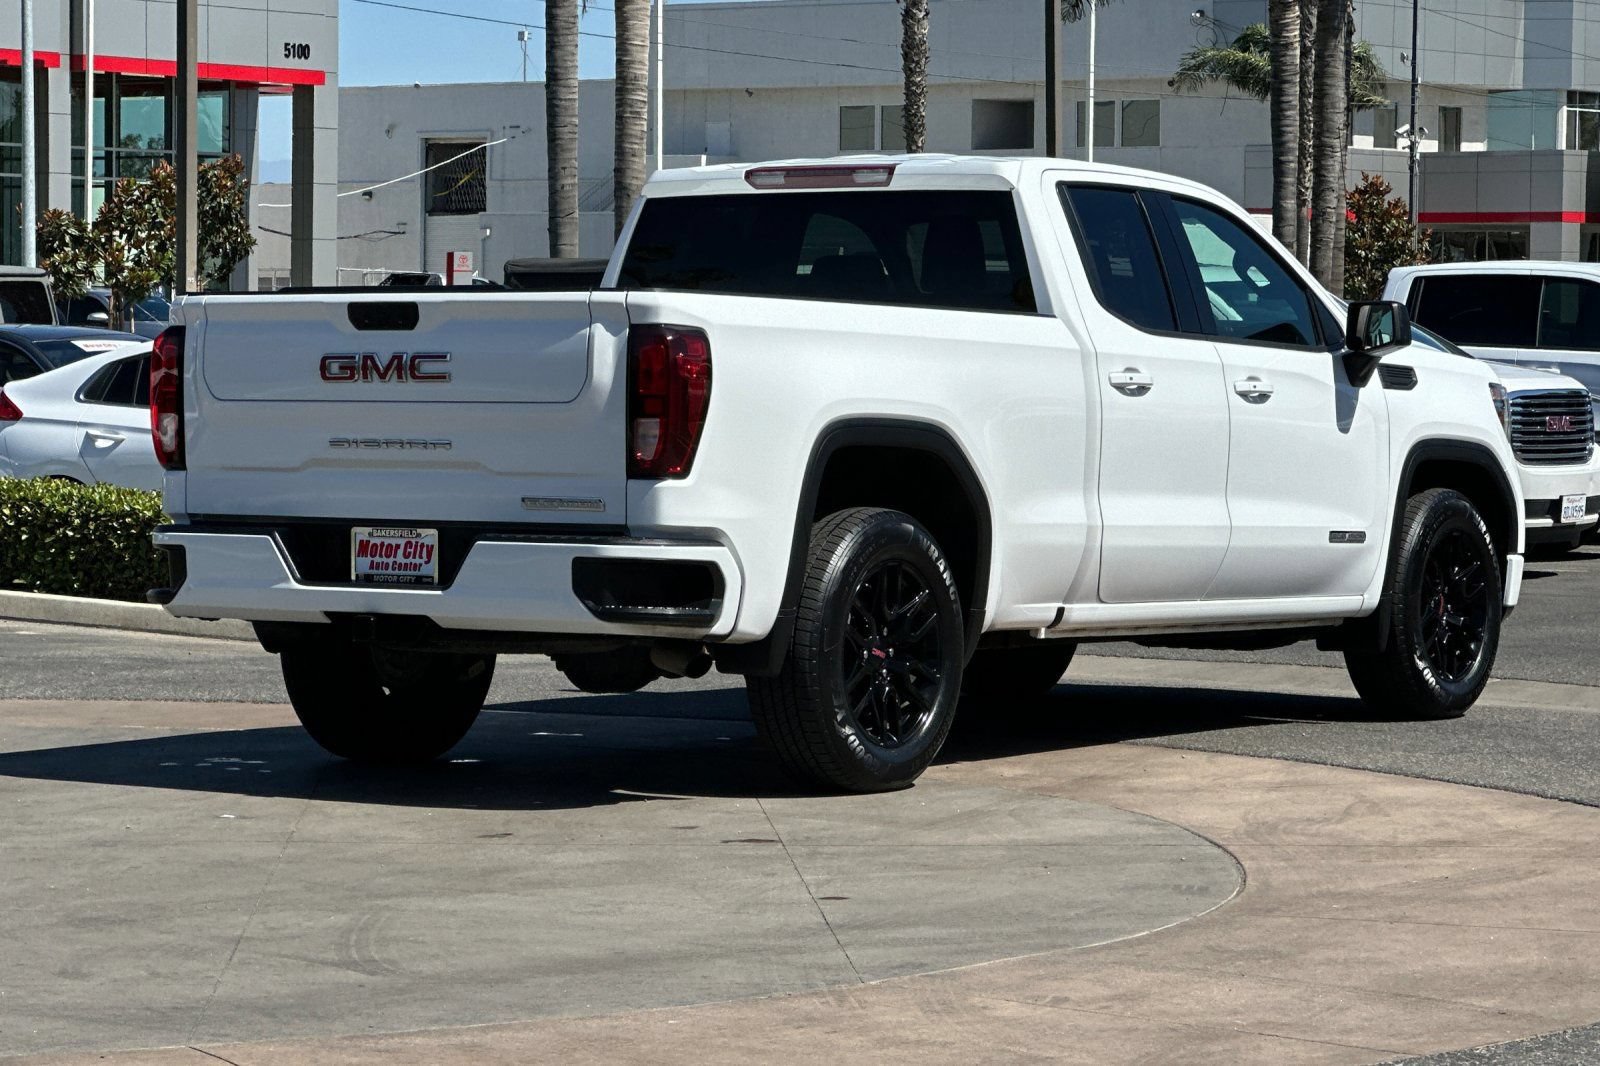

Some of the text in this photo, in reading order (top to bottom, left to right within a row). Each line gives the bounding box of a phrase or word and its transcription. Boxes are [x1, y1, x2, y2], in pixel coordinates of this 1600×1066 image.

[283, 42, 311, 60] 5100
[320, 352, 451, 383] GMC
[328, 438, 452, 450] SIERRA
[372, 529, 417, 538] BAKERSFIELD
[356, 539, 435, 565] Motor City
[368, 560, 422, 572] Auto Center
[373, 574, 417, 583] MOTOR CITY
